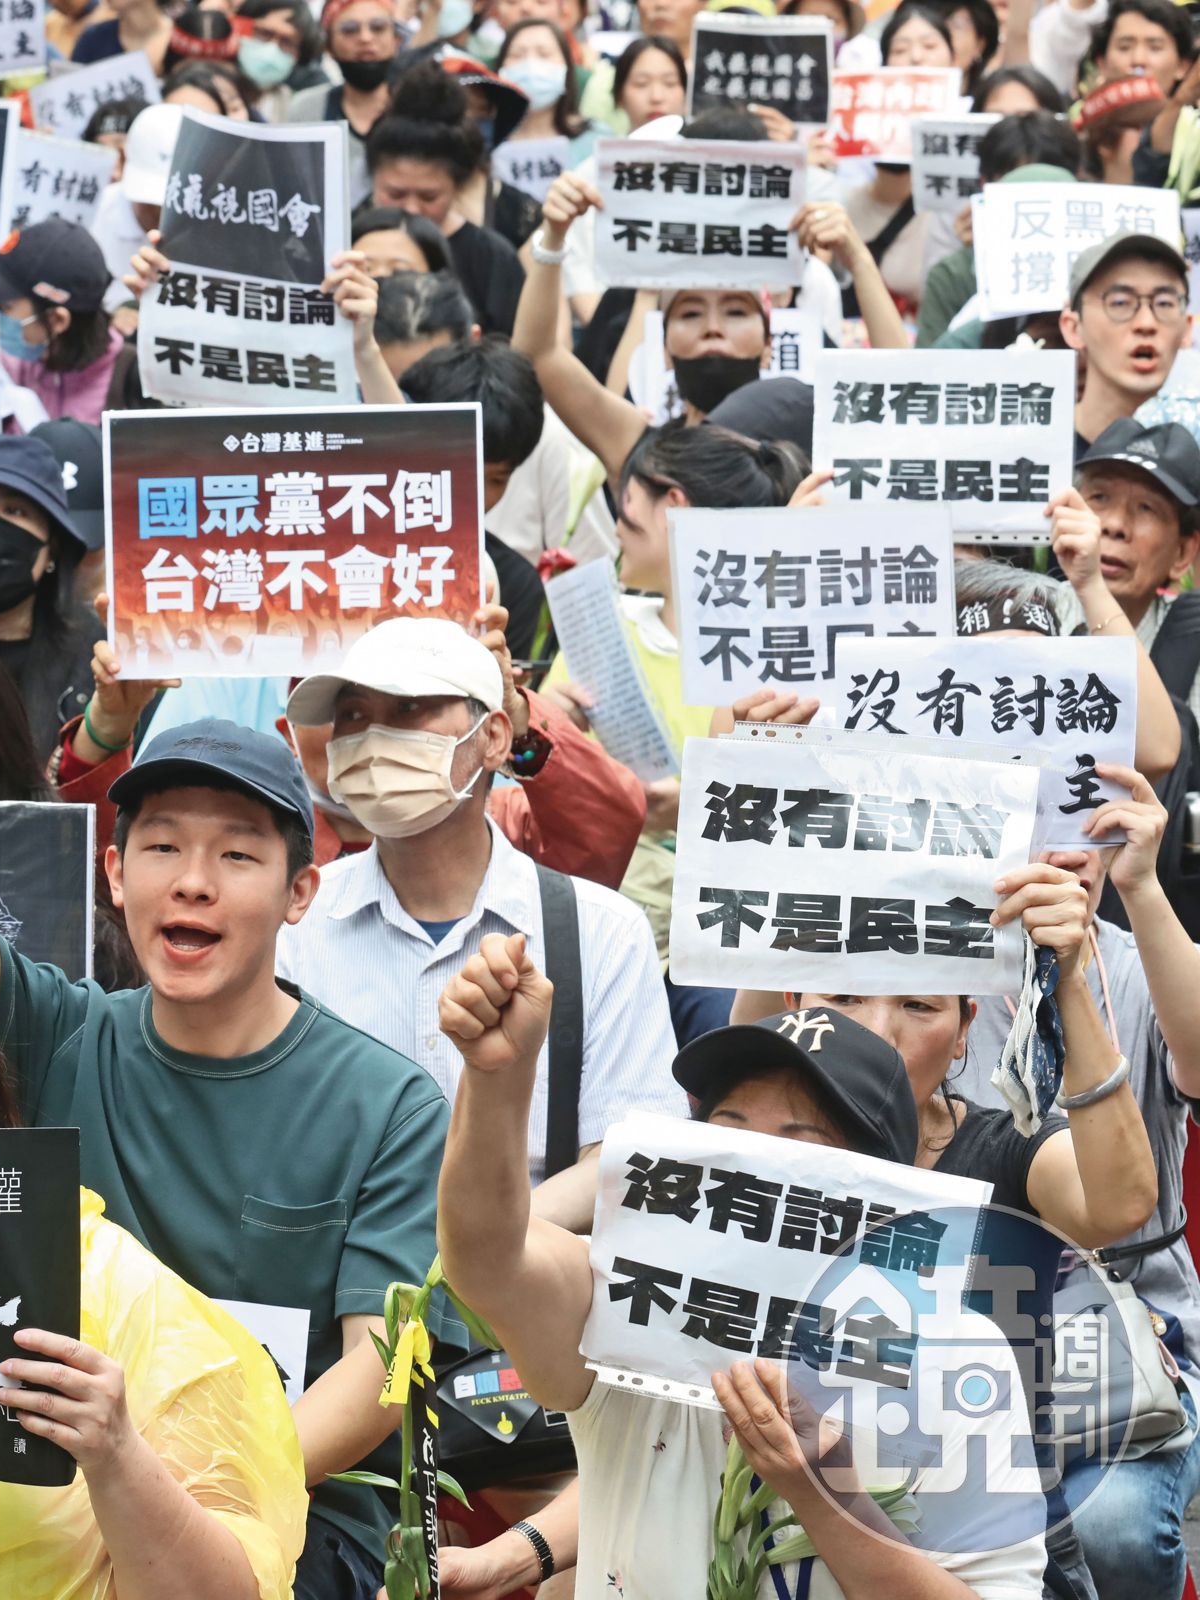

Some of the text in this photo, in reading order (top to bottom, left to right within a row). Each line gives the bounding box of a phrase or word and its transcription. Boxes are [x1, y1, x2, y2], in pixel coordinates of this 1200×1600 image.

[614, 161, 792, 199] 沒有討論
[613, 218, 790, 258] 不是民主
[1011, 201, 1156, 240] 反黑箱
[157, 270, 335, 326] 沒有討論
[1011, 252, 1077, 295] 撐
[155, 337, 337, 392] 不是民主
[832, 381, 1055, 426] 沒有討論
[241, 431, 325, 453] 台灣基進
[137, 469, 453, 540] 國眾黨不倒
[832, 457, 1050, 502] 不是民主
[141, 543, 456, 615] 台灣不會好
[693, 544, 940, 610] 沒有討論
[698, 621, 938, 684] 不是
[842, 667, 1123, 737] 沒有討論
[700, 779, 1012, 860] 沒有討論
[696, 886, 996, 960] 不是民主
[625, 1151, 949, 1277] 沒有討論
[608, 1256, 920, 1390] 不是民主
